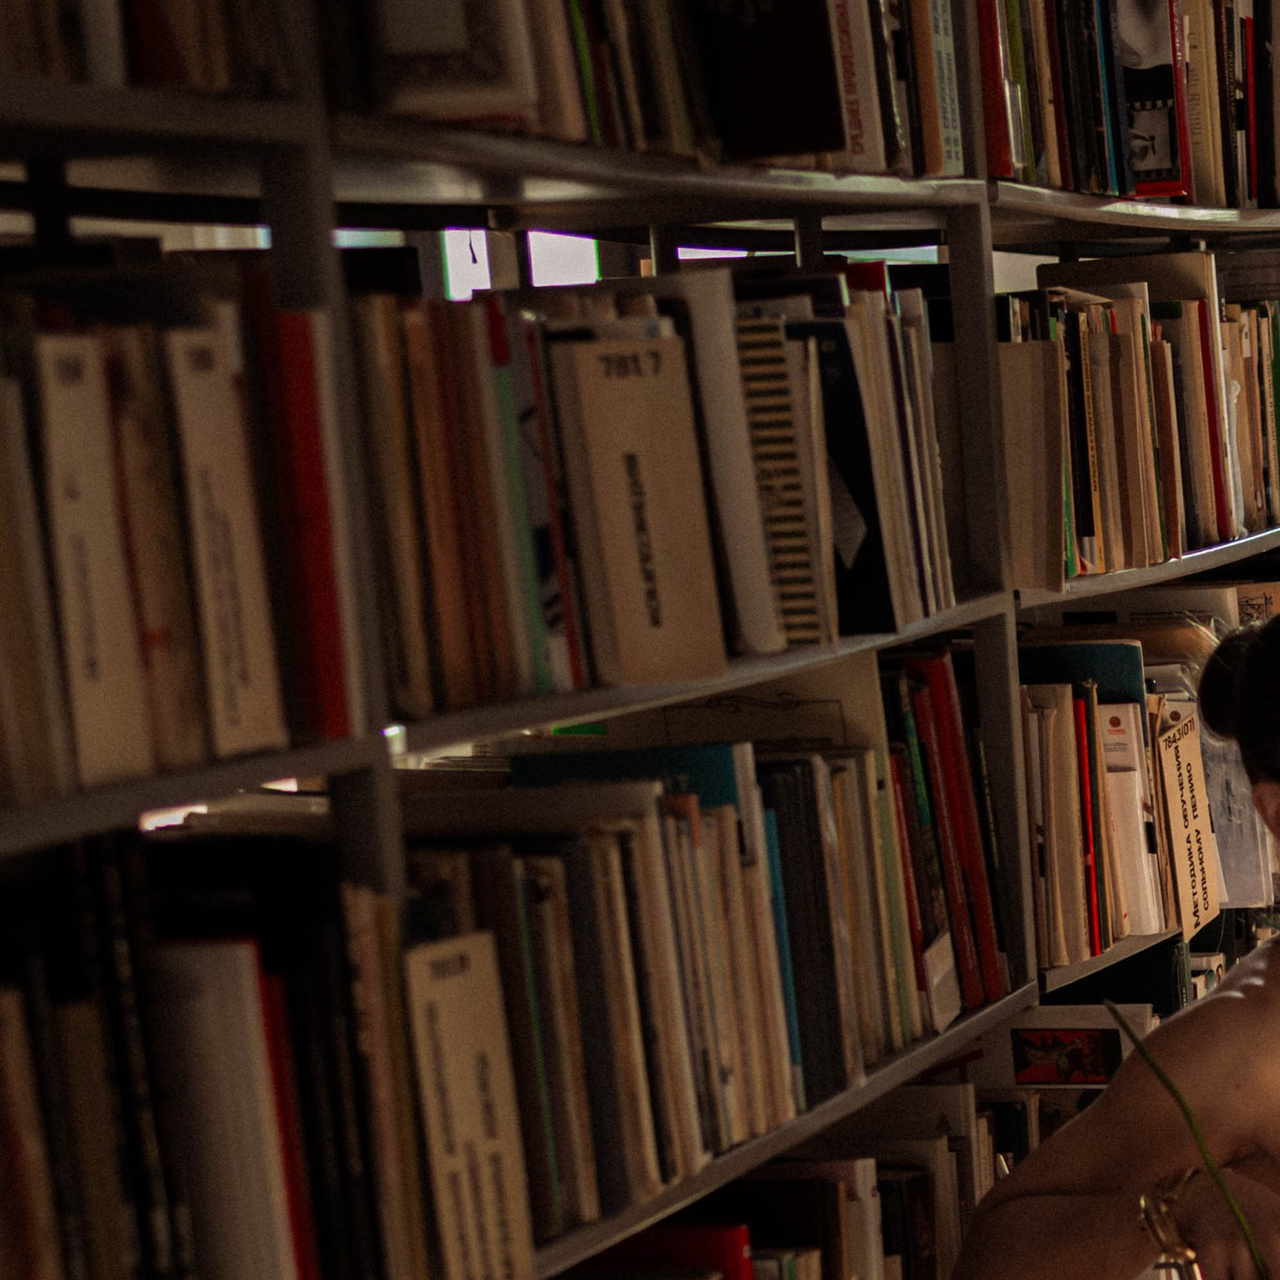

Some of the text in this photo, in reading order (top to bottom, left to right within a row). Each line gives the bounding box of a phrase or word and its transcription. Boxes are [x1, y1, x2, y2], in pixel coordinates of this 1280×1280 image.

[1172, 744, 1190, 830] ОБУЧЕНИЯ
[1185, 762, 1210, 912] СОЛЬНОМУ ПЕНИЮ
